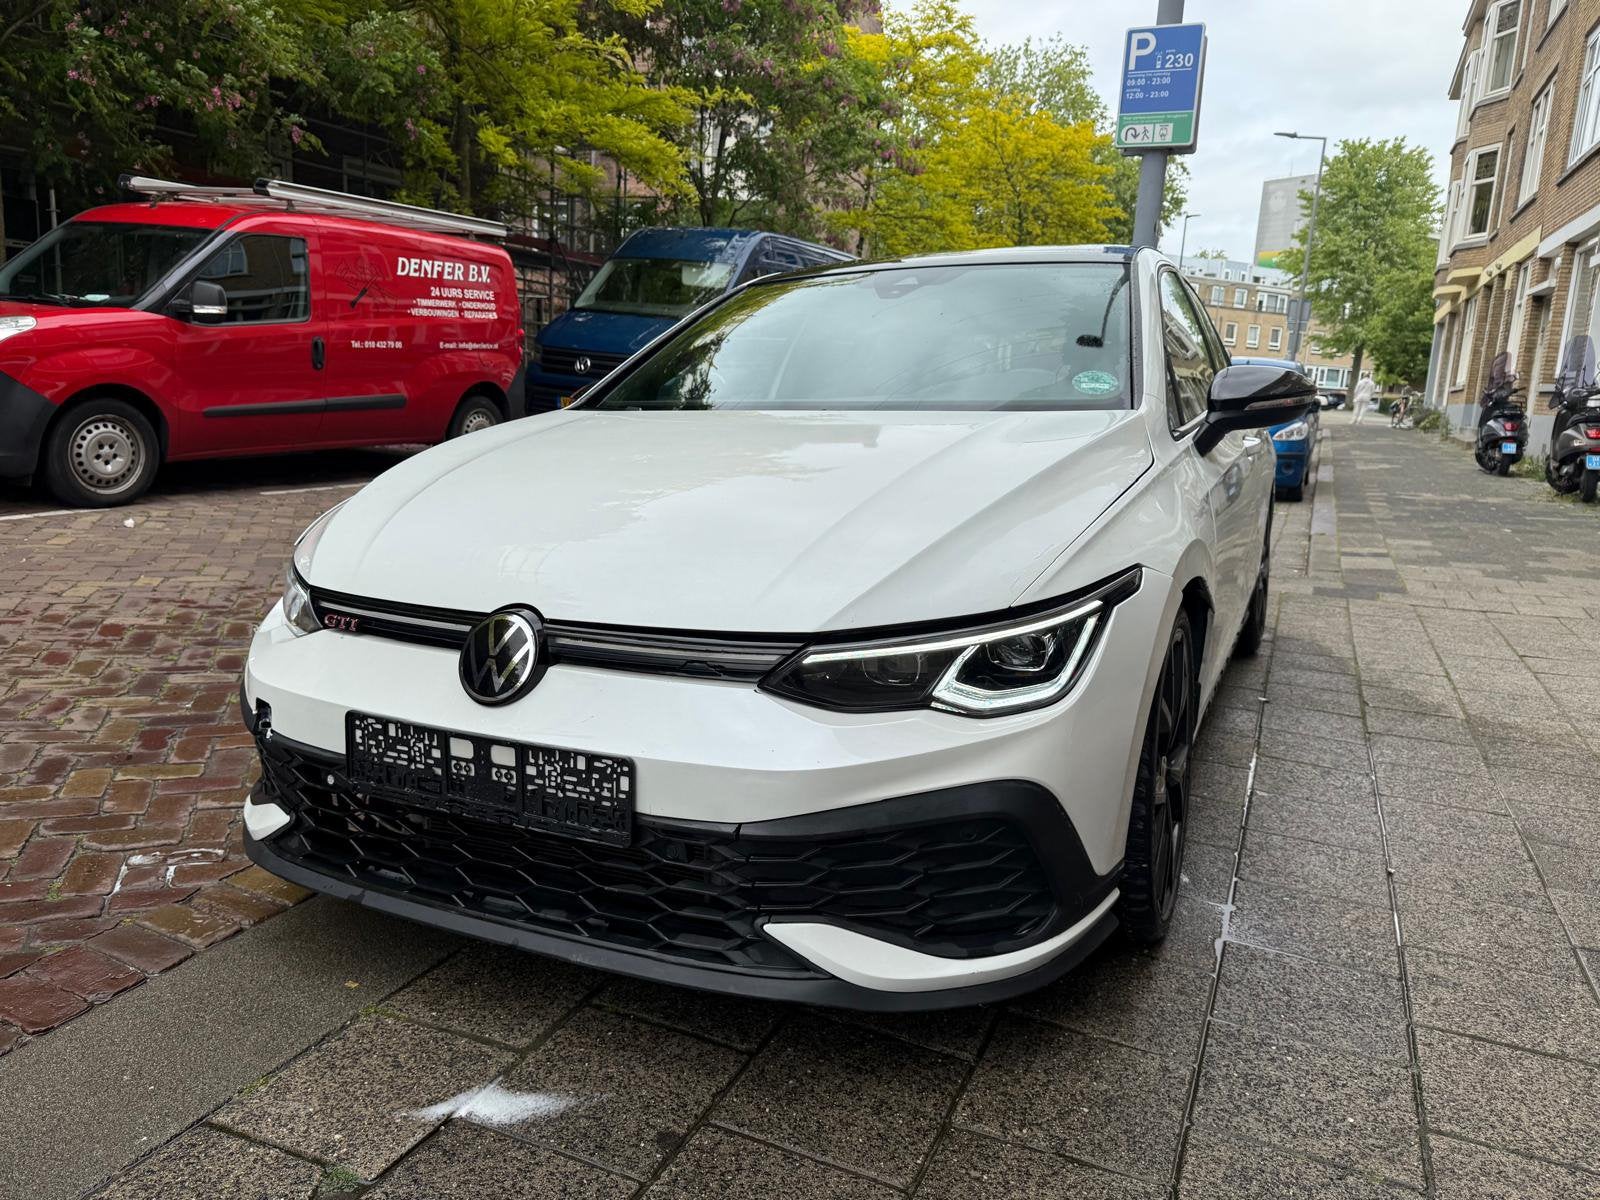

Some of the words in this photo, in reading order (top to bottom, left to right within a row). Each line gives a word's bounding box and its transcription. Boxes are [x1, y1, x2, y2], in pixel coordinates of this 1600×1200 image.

[1128, 32, 1157, 71] P
[1164, 53, 1194, 68] 230
[1151, 77, 1171, 85] 23:00
[1150, 90, 1169, 98] 23:00
[397, 257, 464, 281] DENFER
[468, 264, 491, 283] B.V.
[430, 286, 440, 297] 24
[441, 287, 463, 298] UURS
[463, 289, 495, 301] SERVICE
[324, 613, 359, 632] GTI
